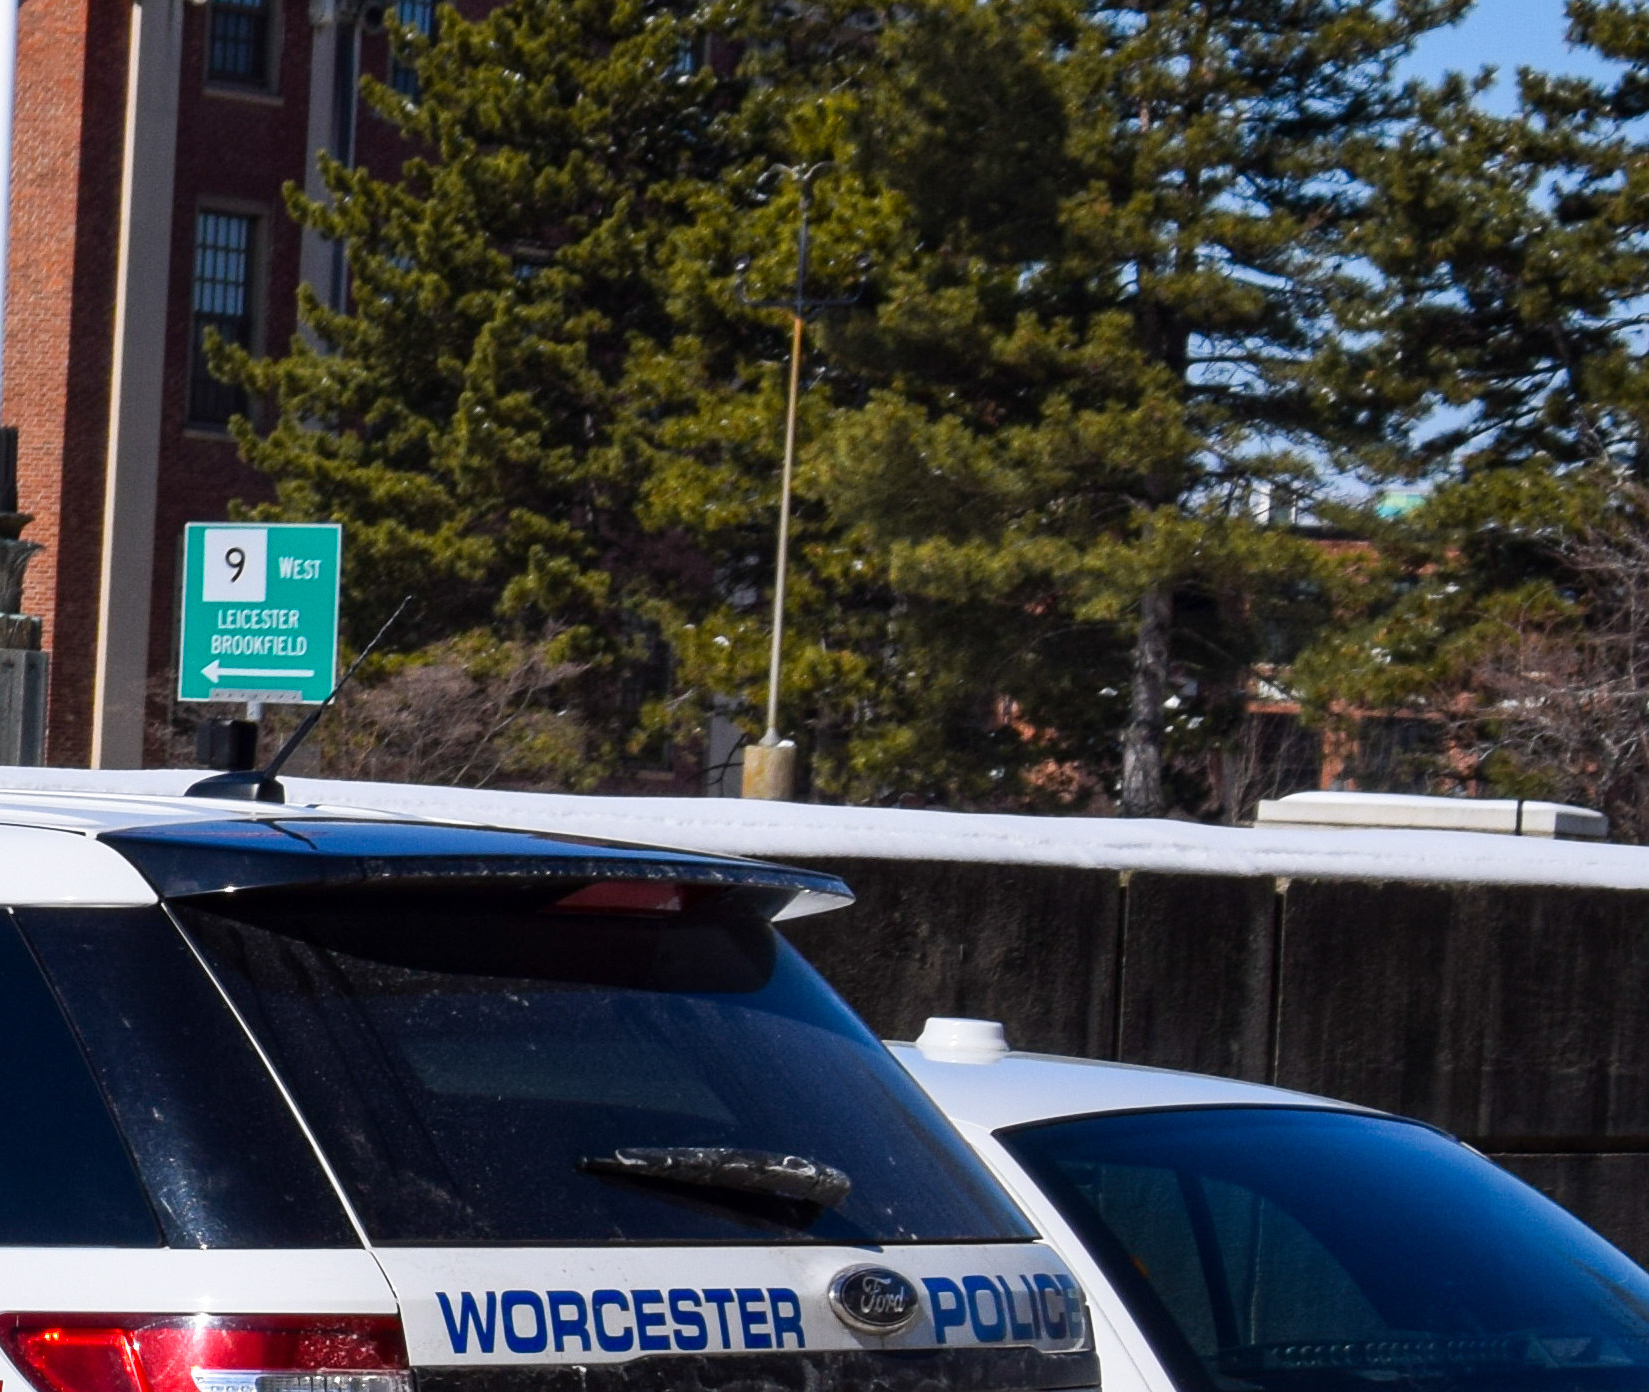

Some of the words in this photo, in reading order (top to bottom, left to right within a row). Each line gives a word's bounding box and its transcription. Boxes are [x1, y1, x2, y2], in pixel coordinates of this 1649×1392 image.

[225, 547, 246, 583] 9
[278, 557, 322, 580] WEST
[217, 609, 300, 629] LEICESTER
[210, 634, 308, 656] BROOKFIELD
[860, 1275, 905, 1314] Ford
[436, 1286, 805, 1355] WORCESTER
